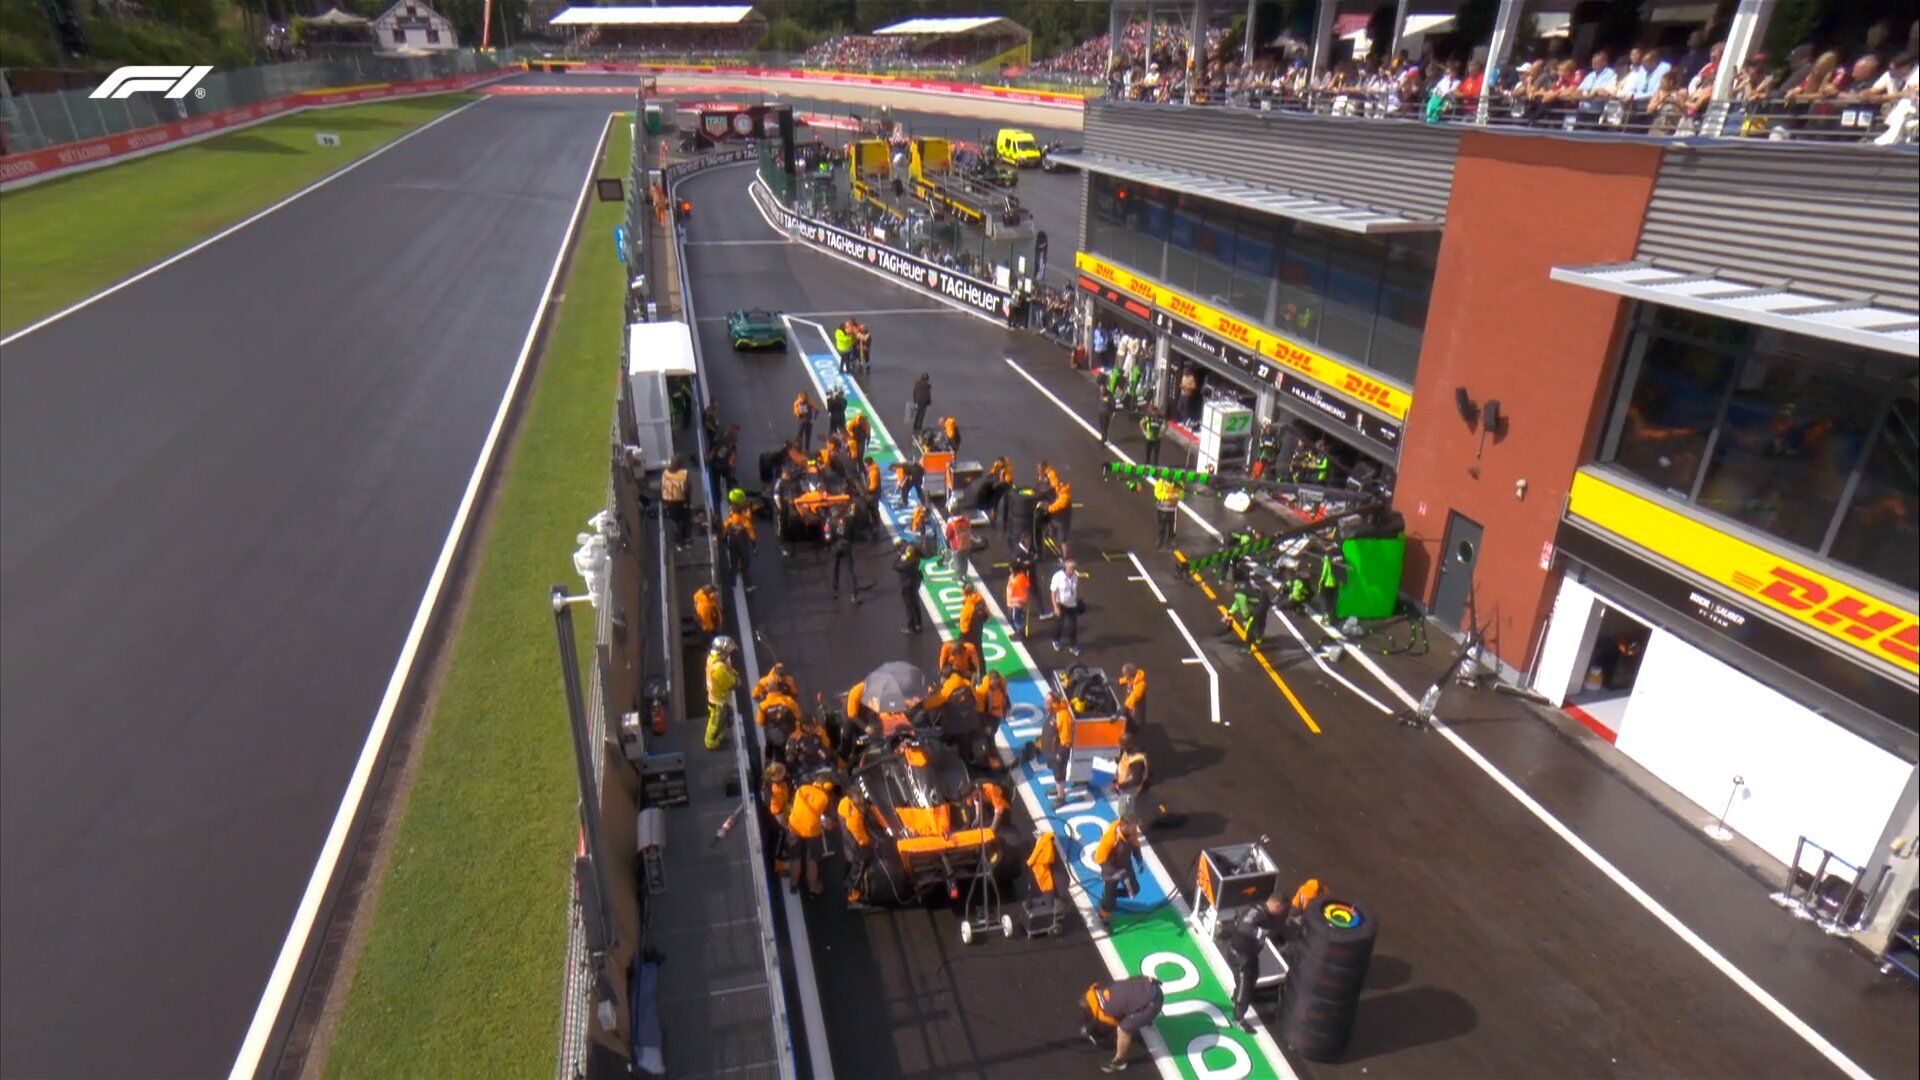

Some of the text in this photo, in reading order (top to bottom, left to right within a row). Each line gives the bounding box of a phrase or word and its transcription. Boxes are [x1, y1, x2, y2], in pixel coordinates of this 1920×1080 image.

[825, 231, 867, 260] TAGHeuer
[877, 250, 927, 284] TAGHeuer
[1096, 262, 1115, 281] DHL
[940, 273, 1000, 312] TAGHeuer
[1129, 279, 1153, 298] DHL
[1169, 296, 1198, 320] DHL
[1218, 318, 1249, 343] DHL
[1274, 342, 1313, 373] DHL
[1343, 373, 1392, 409] DHL
[1225, 415, 1250, 432] 27
